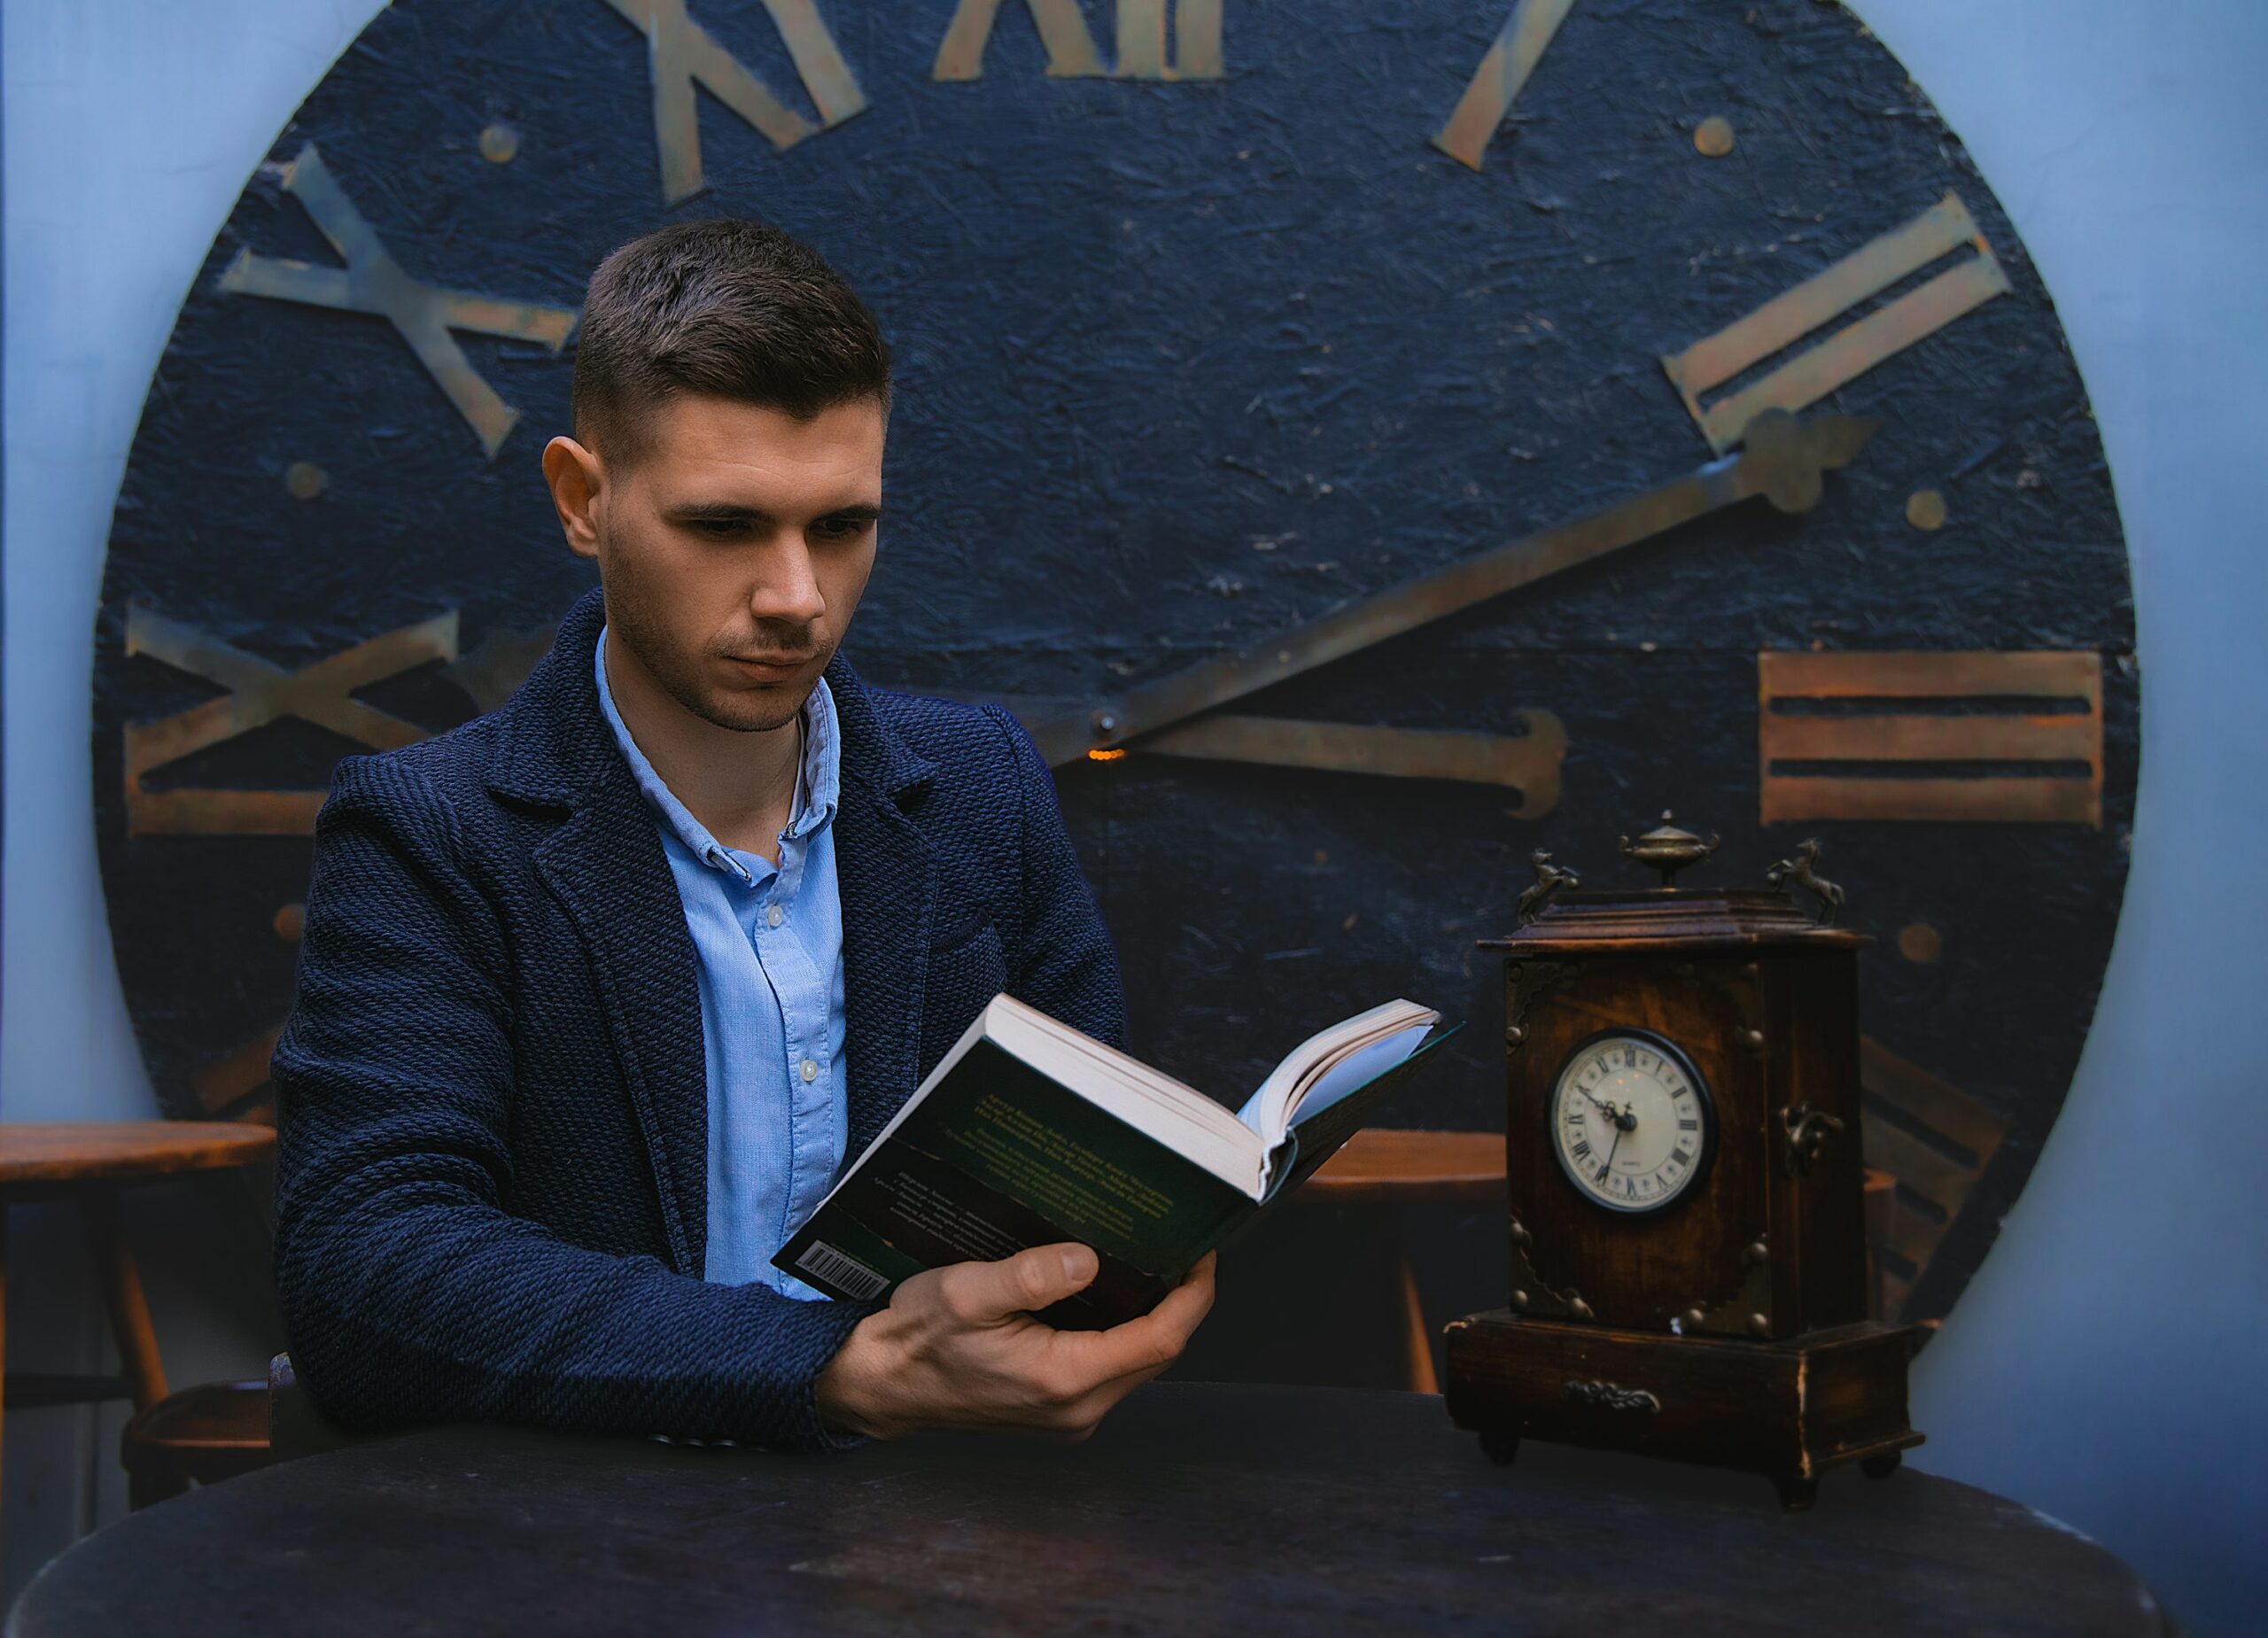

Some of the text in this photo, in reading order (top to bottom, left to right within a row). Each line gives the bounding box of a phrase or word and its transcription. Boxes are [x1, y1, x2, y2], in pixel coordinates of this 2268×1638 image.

[220, 142, 579, 459] X
[1659, 189, 2014, 458] II
[1758, 649, 2104, 829] III
[1671, 1086, 1688, 1099] II
[1679, 1119, 1697, 1131] III
